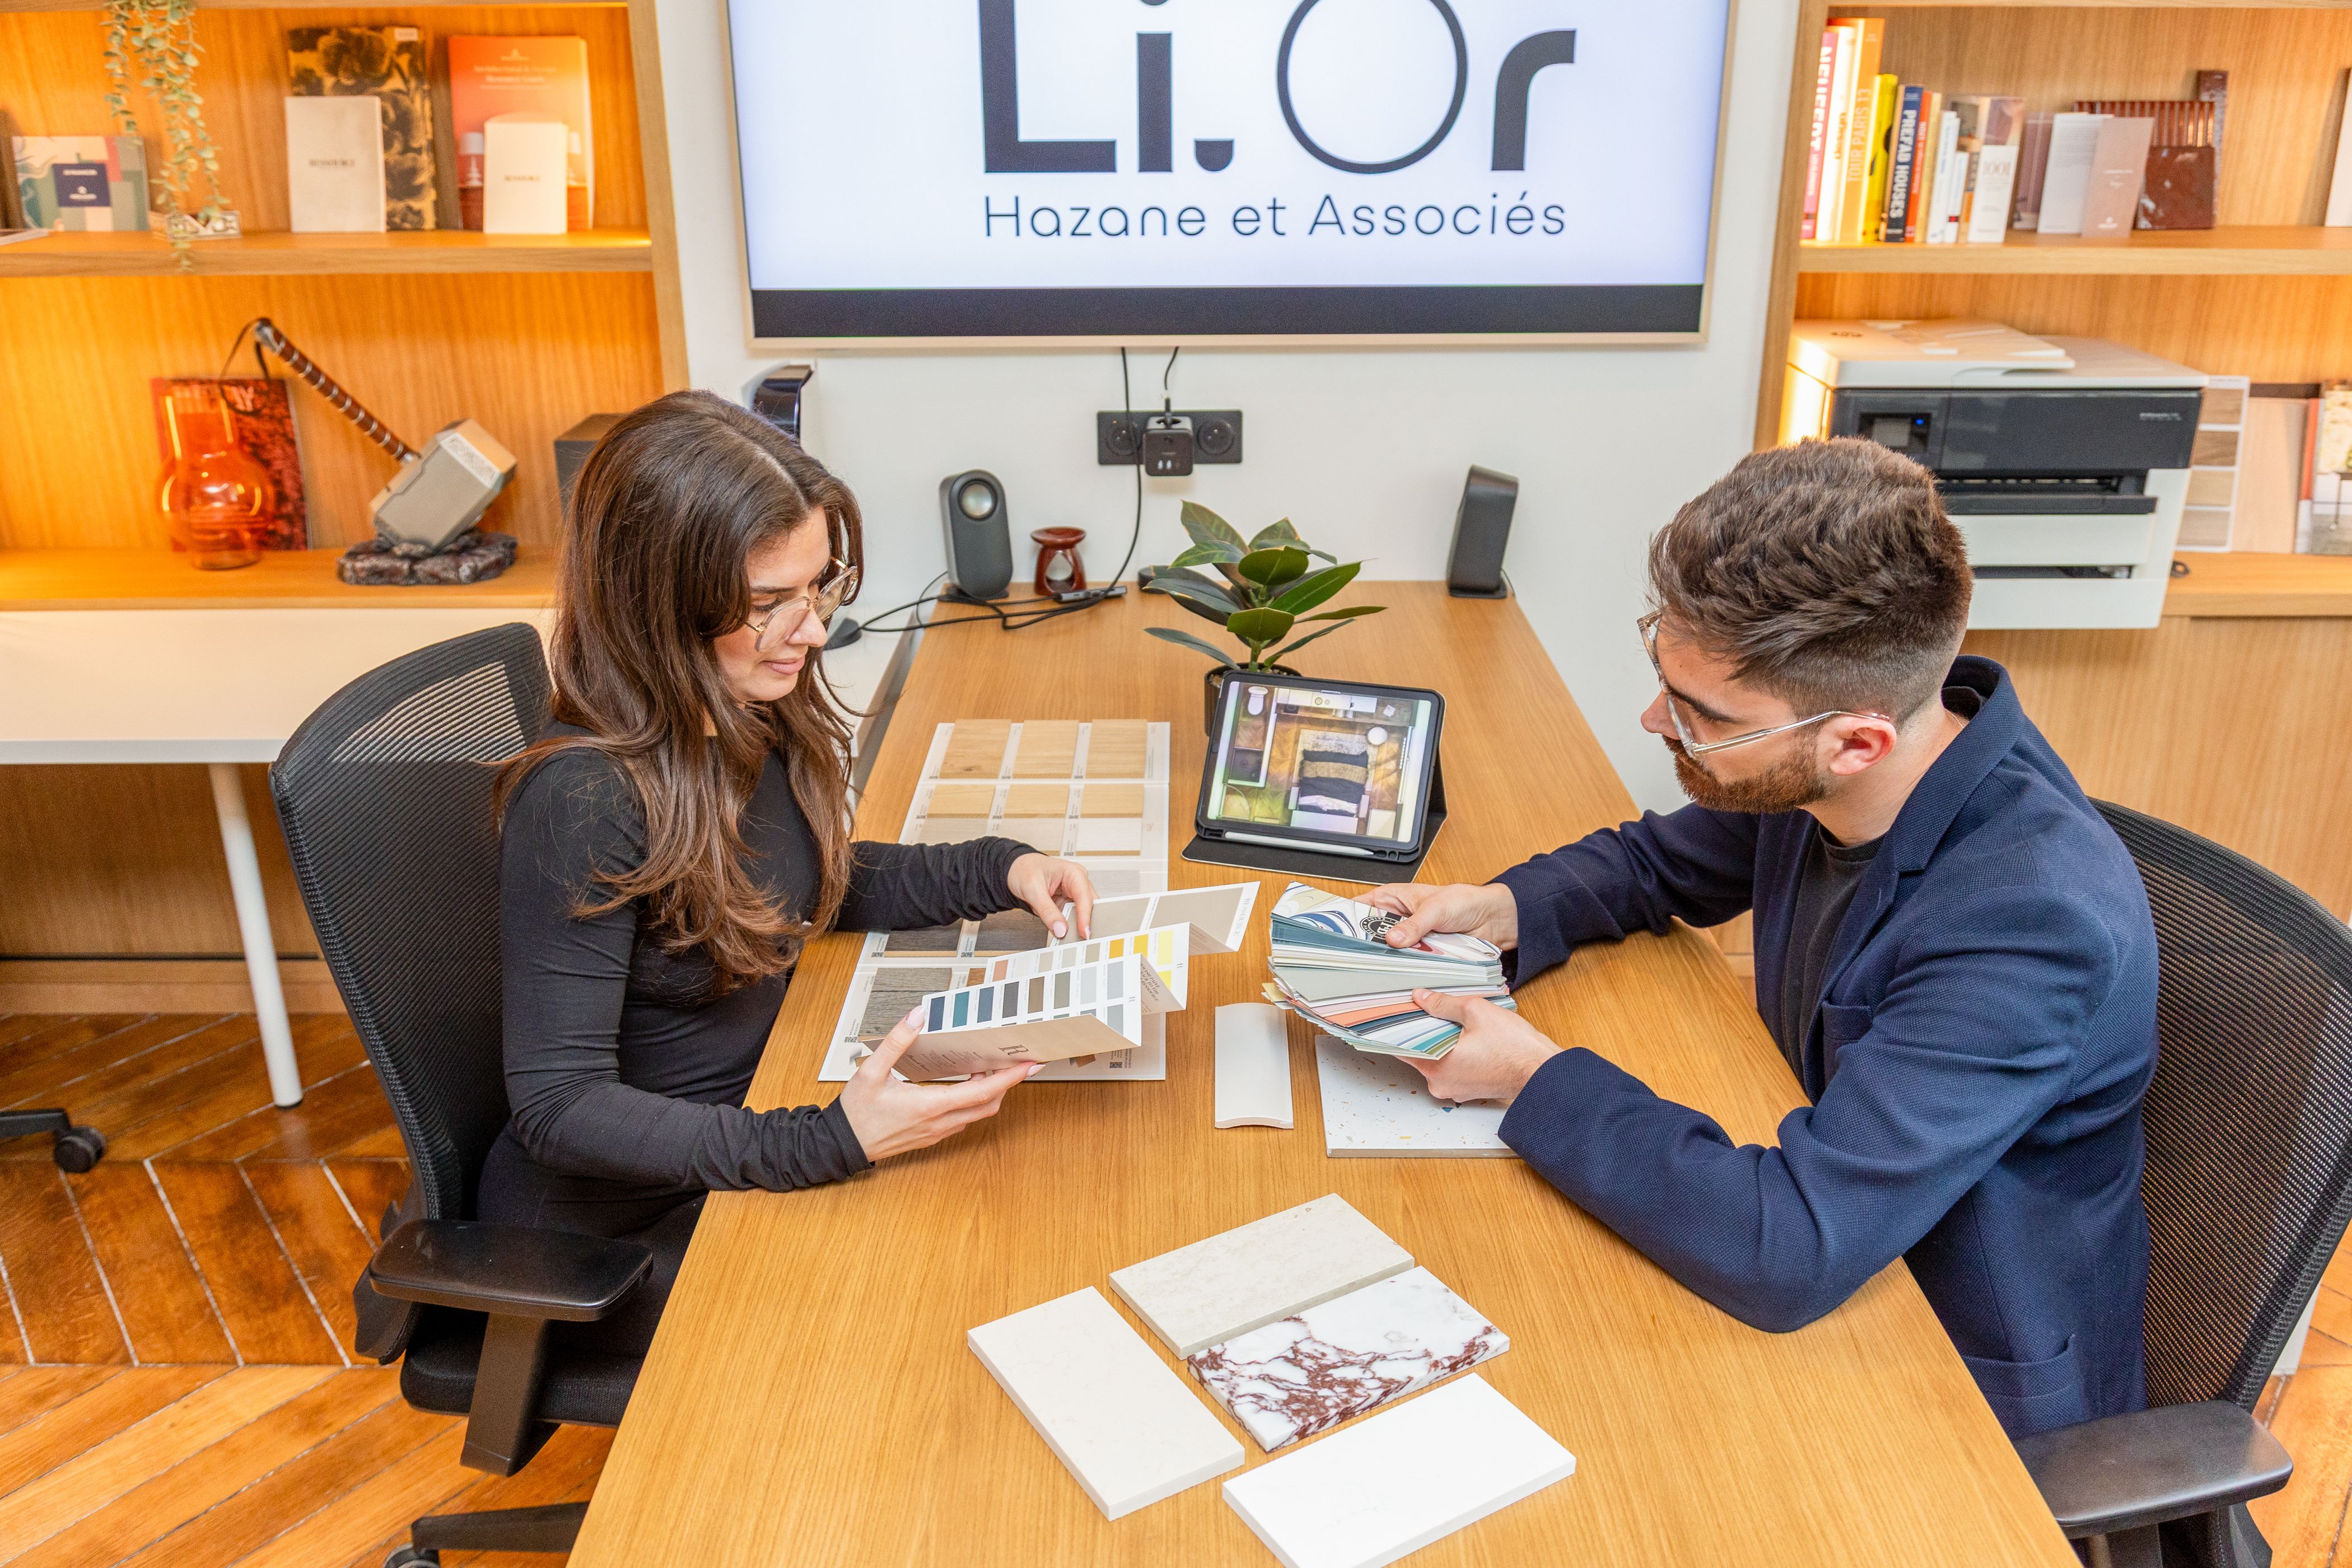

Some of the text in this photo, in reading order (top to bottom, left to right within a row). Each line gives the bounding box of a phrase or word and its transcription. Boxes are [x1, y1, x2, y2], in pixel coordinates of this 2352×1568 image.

[1848, 88, 1870, 182] TOUR PARIS 13
[1897, 110, 1917, 163] PREFAB
[986, 192, 1564, 236] Hazane et Associés
[1889, 165, 1910, 218] HOUSES
[1233, 898, 1250, 936] RESSOURCE
[998, 1044, 1029, 1056] R
